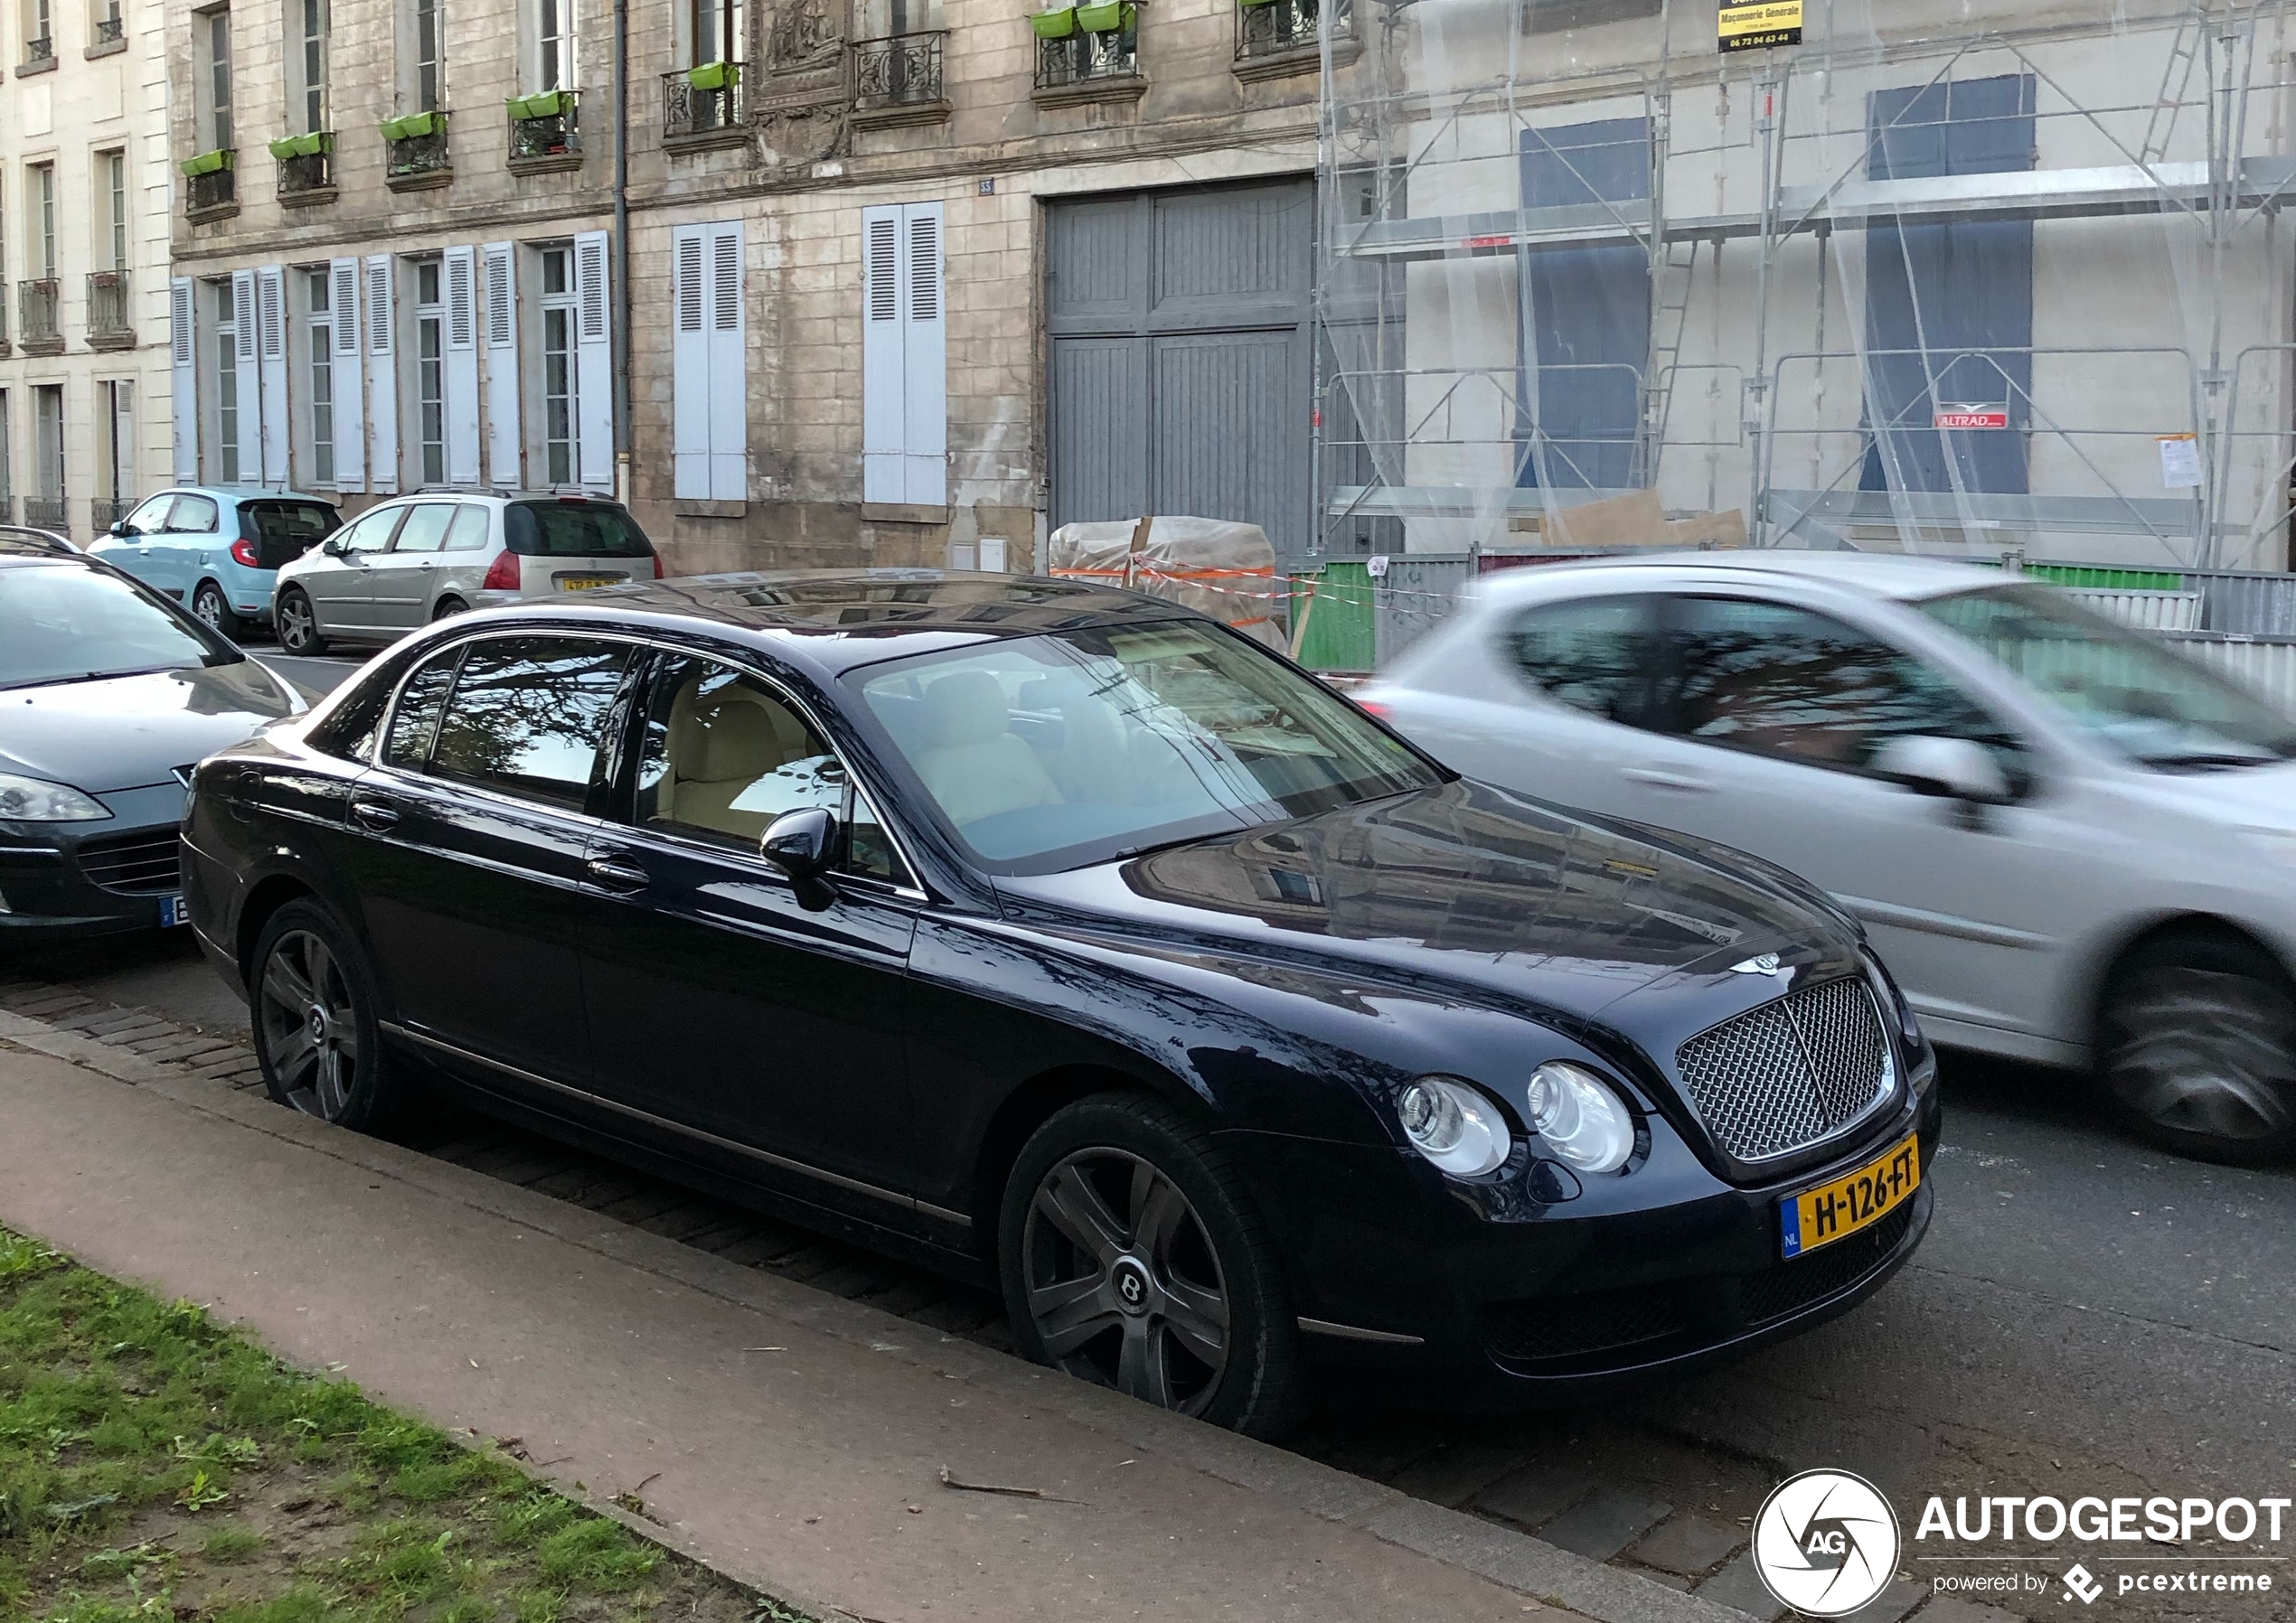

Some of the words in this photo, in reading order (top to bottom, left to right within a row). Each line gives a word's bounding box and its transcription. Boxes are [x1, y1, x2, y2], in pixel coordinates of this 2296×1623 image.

[1721, 10, 1764, 24] Maçonnerie
[1765, 5, 1799, 18] Générale
[1730, 39, 1740, 47] 06
[1742, 37, 1752, 46] 72
[1754, 36, 1764, 44] 04
[1765, 34, 1775, 43] 63
[1777, 33, 1788, 42] 44
[1939, 416, 1988, 427] ALTRAD
[1815, 1146, 1913, 1237] H-126-FT
[1784, 1234, 1798, 1248] NL
